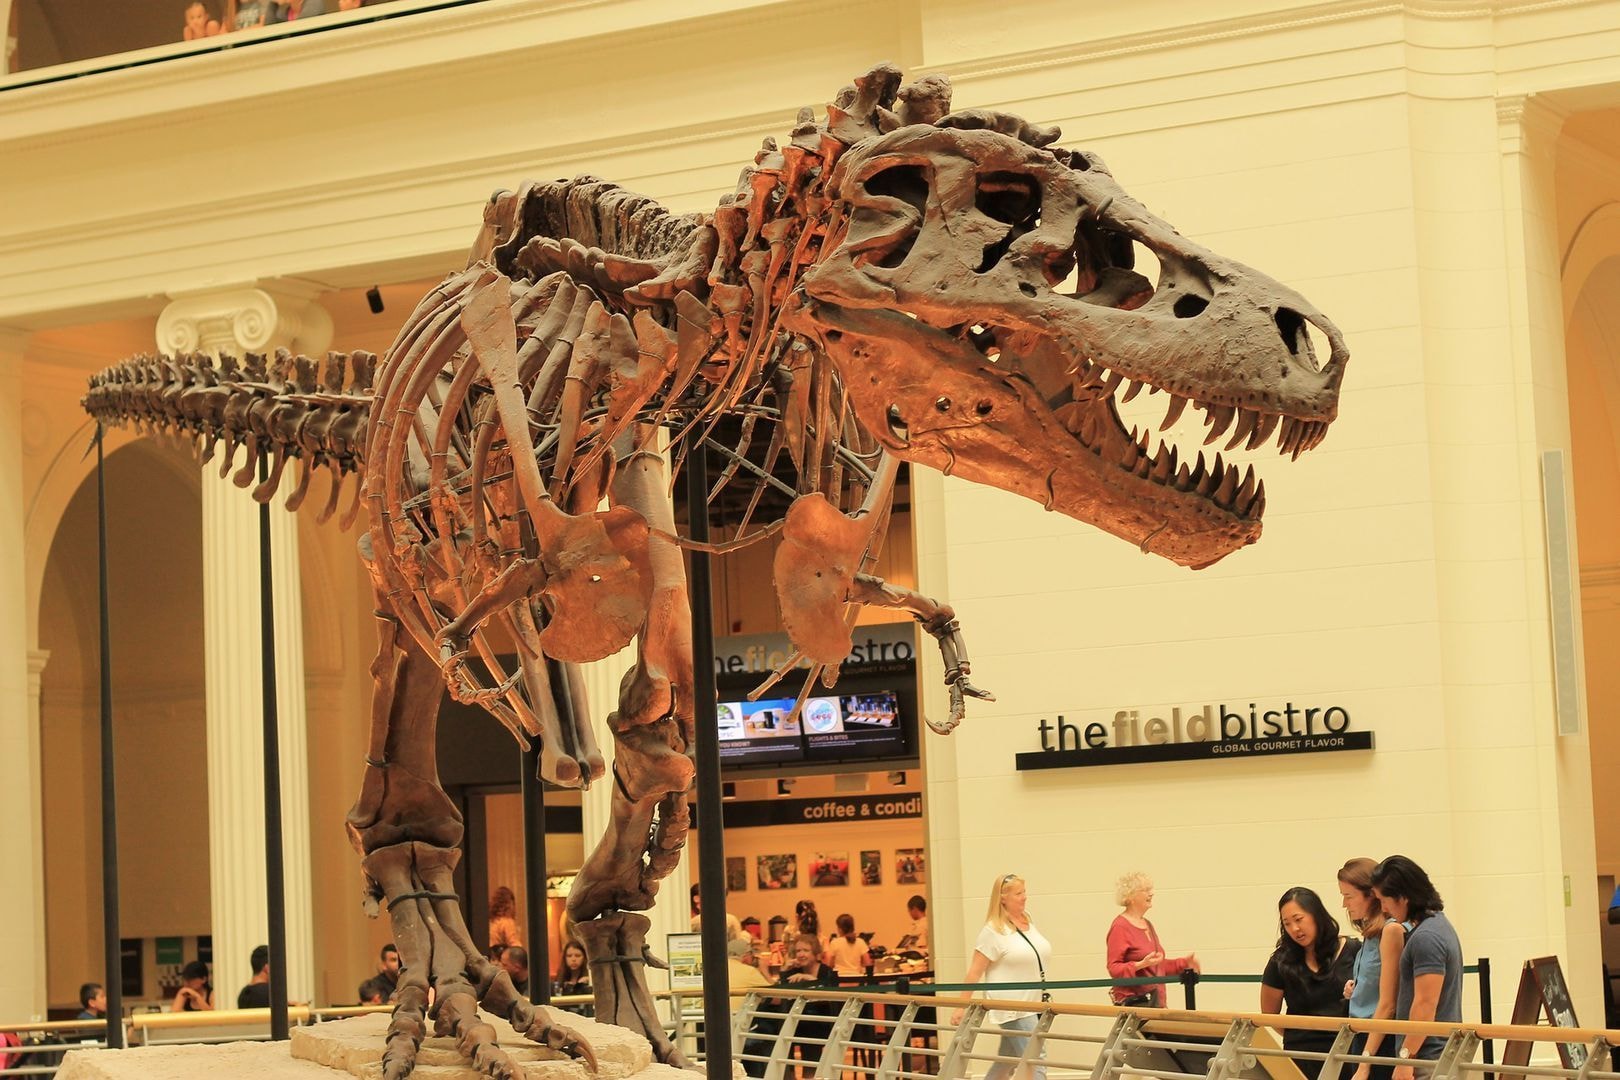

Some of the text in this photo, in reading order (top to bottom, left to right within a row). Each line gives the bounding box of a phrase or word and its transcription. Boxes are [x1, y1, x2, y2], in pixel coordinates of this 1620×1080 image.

[1212, 737, 1345, 753] GLOBAL GOURMET FLAVOR
[803, 798, 921, 819] coffee & condi
